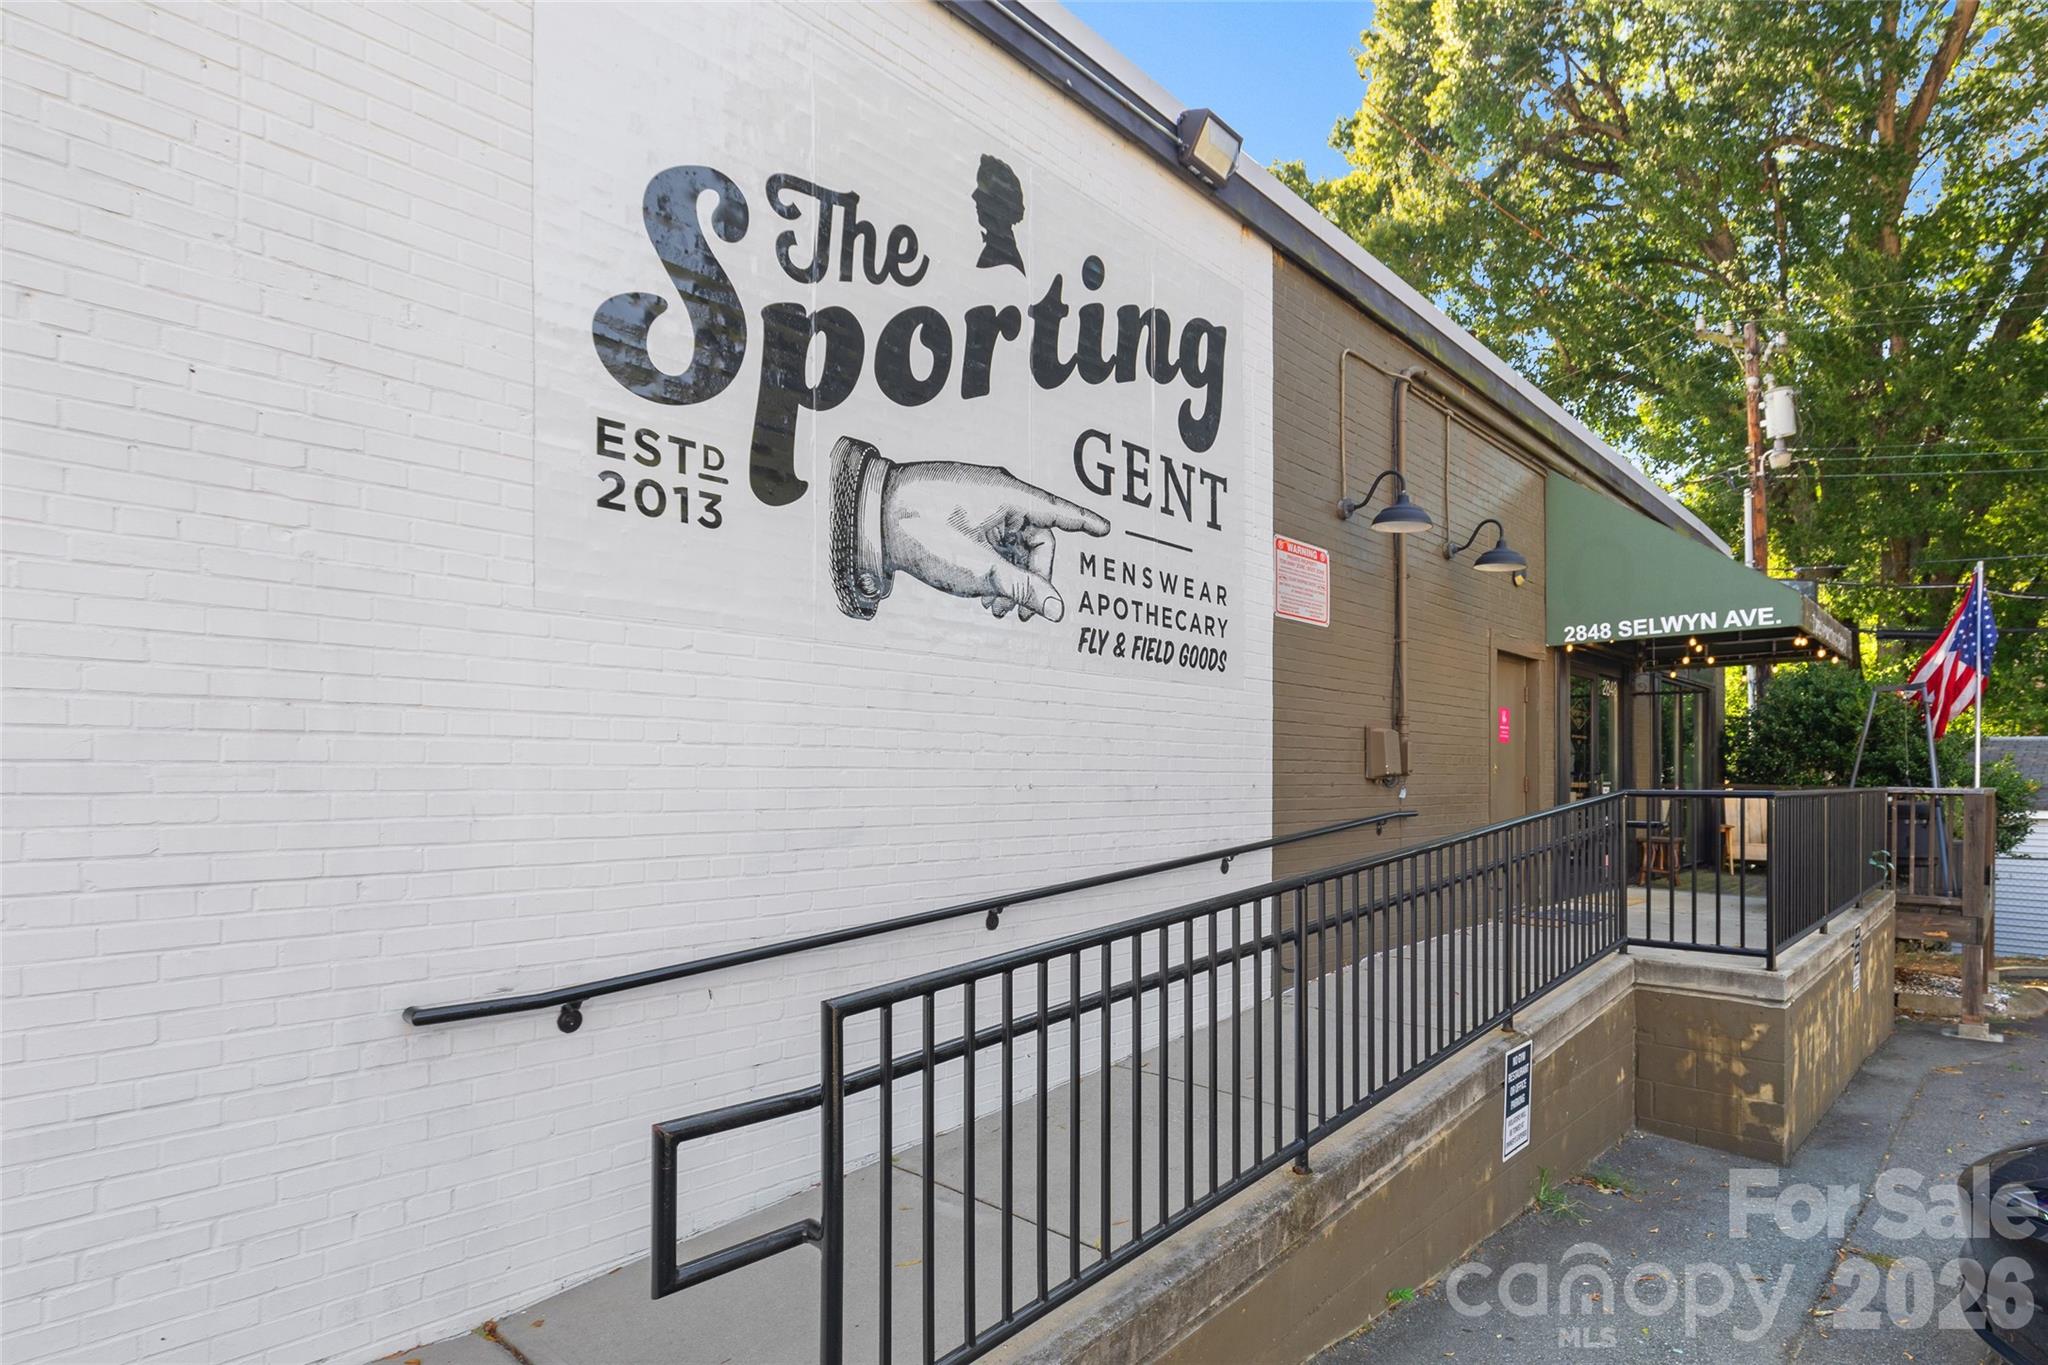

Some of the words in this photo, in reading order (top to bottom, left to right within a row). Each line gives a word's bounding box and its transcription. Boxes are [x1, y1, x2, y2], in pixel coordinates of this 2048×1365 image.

[766, 173, 929, 287] The
[591, 165, 1227, 507] Sporting
[597, 470, 723, 529] 2013
[1073, 428, 1227, 531] GENT
[1080, 551, 1227, 606] MENSWEAR
[1288, 542, 1318, 560] WARNING
[1078, 590, 1228, 638] APOTHECARY
[1564, 622, 1612, 643] 2848
[1618, 612, 1717, 638] SELWYN
[1723, 607, 1782, 628] AVE.
[1078, 627, 1109, 656] FLY
[1113, 632, 1126, 658] &
[1131, 635, 1174, 665] FIELD
[1179, 643, 1227, 672] GOODS
